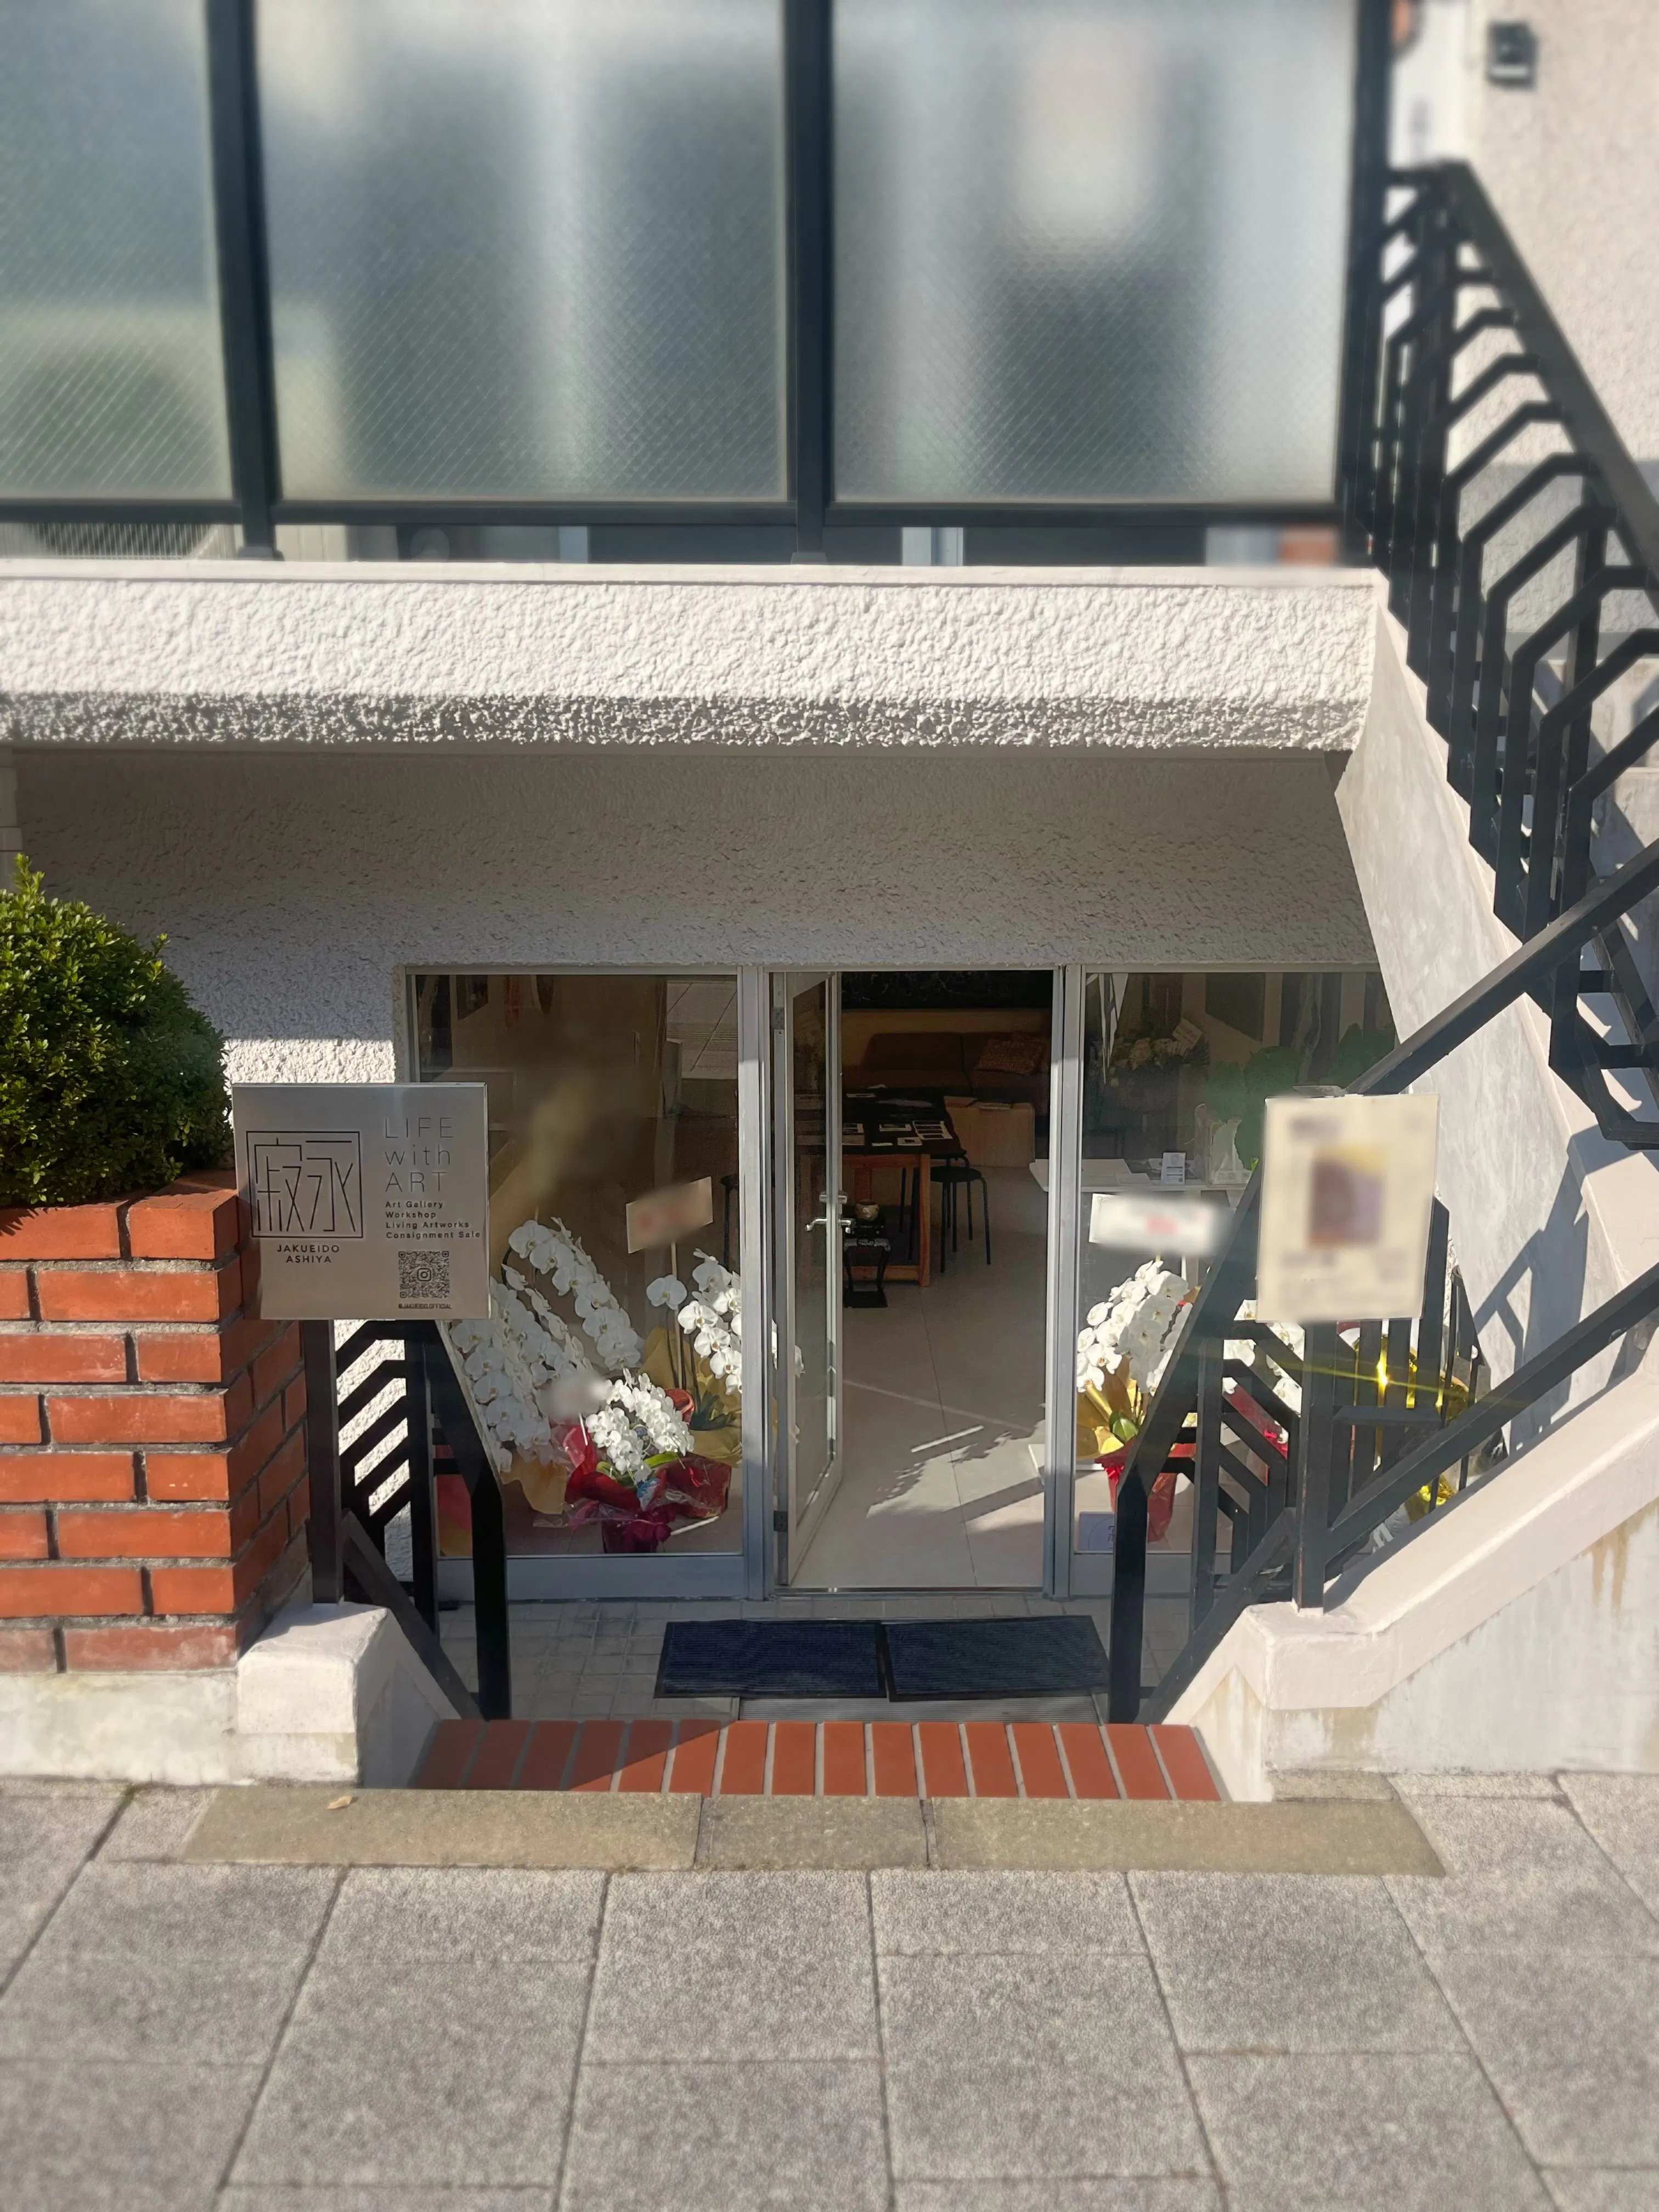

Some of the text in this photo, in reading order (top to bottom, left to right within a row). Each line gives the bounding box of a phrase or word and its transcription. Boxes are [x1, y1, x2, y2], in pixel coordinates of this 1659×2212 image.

[385, 1118, 454, 1138] LIFE
[385, 1143, 450, 1165] with
[385, 1171, 447, 1192] ART
[386, 1232, 454, 1240] Consignment
[276, 1244, 340, 1253] JAKUEIDO
[286, 1255, 332, 1263] ASHIYA
